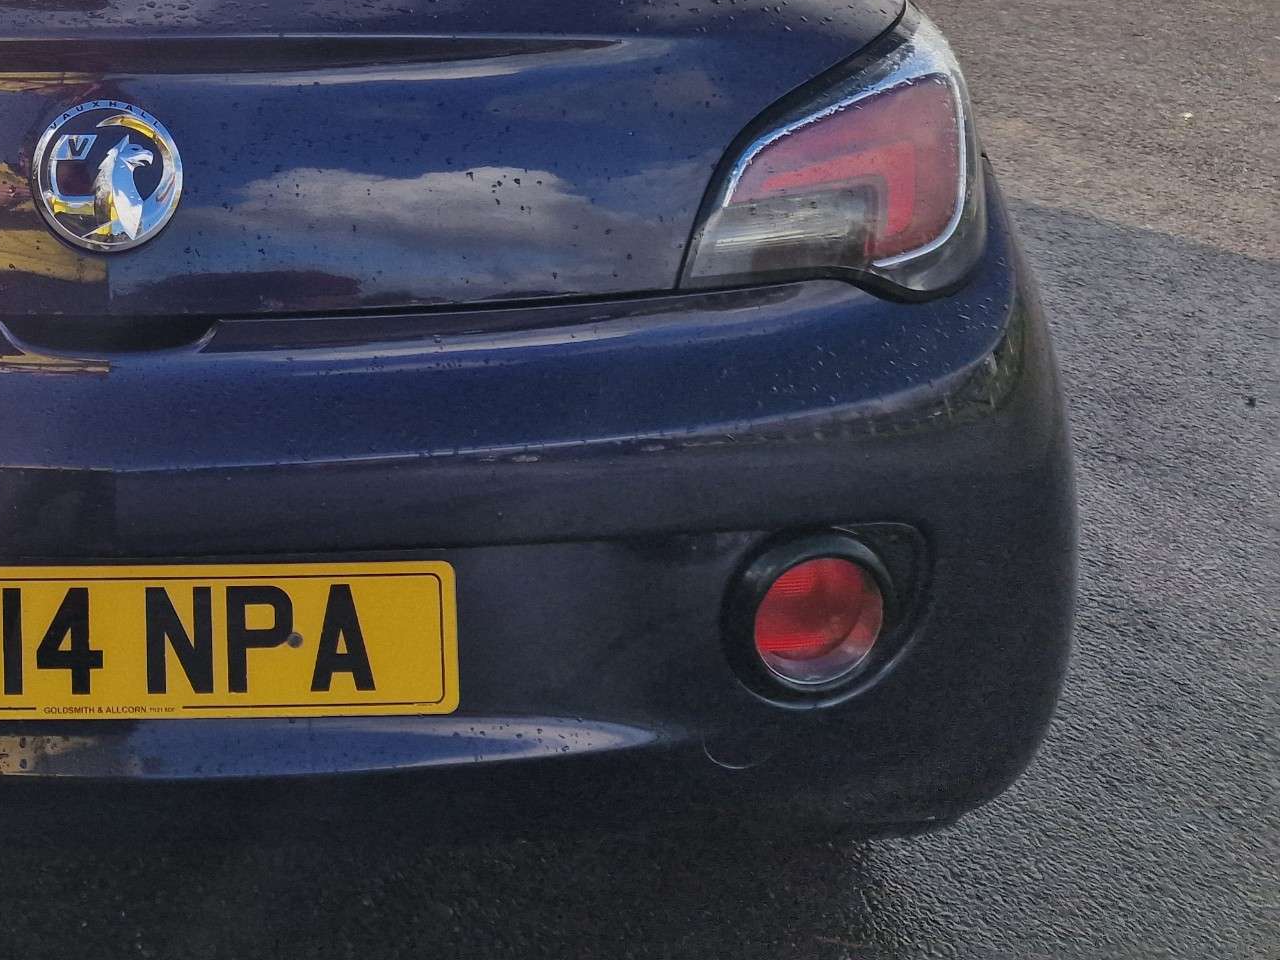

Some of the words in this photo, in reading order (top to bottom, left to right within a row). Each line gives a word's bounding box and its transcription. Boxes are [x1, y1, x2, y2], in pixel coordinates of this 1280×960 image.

[49, 101, 161, 130] VAUXHALL
[144, 583, 376, 695] NPA
[43, 706, 95, 714] GOLDSMITH
[105, 705, 147, 713] ALLCORN
